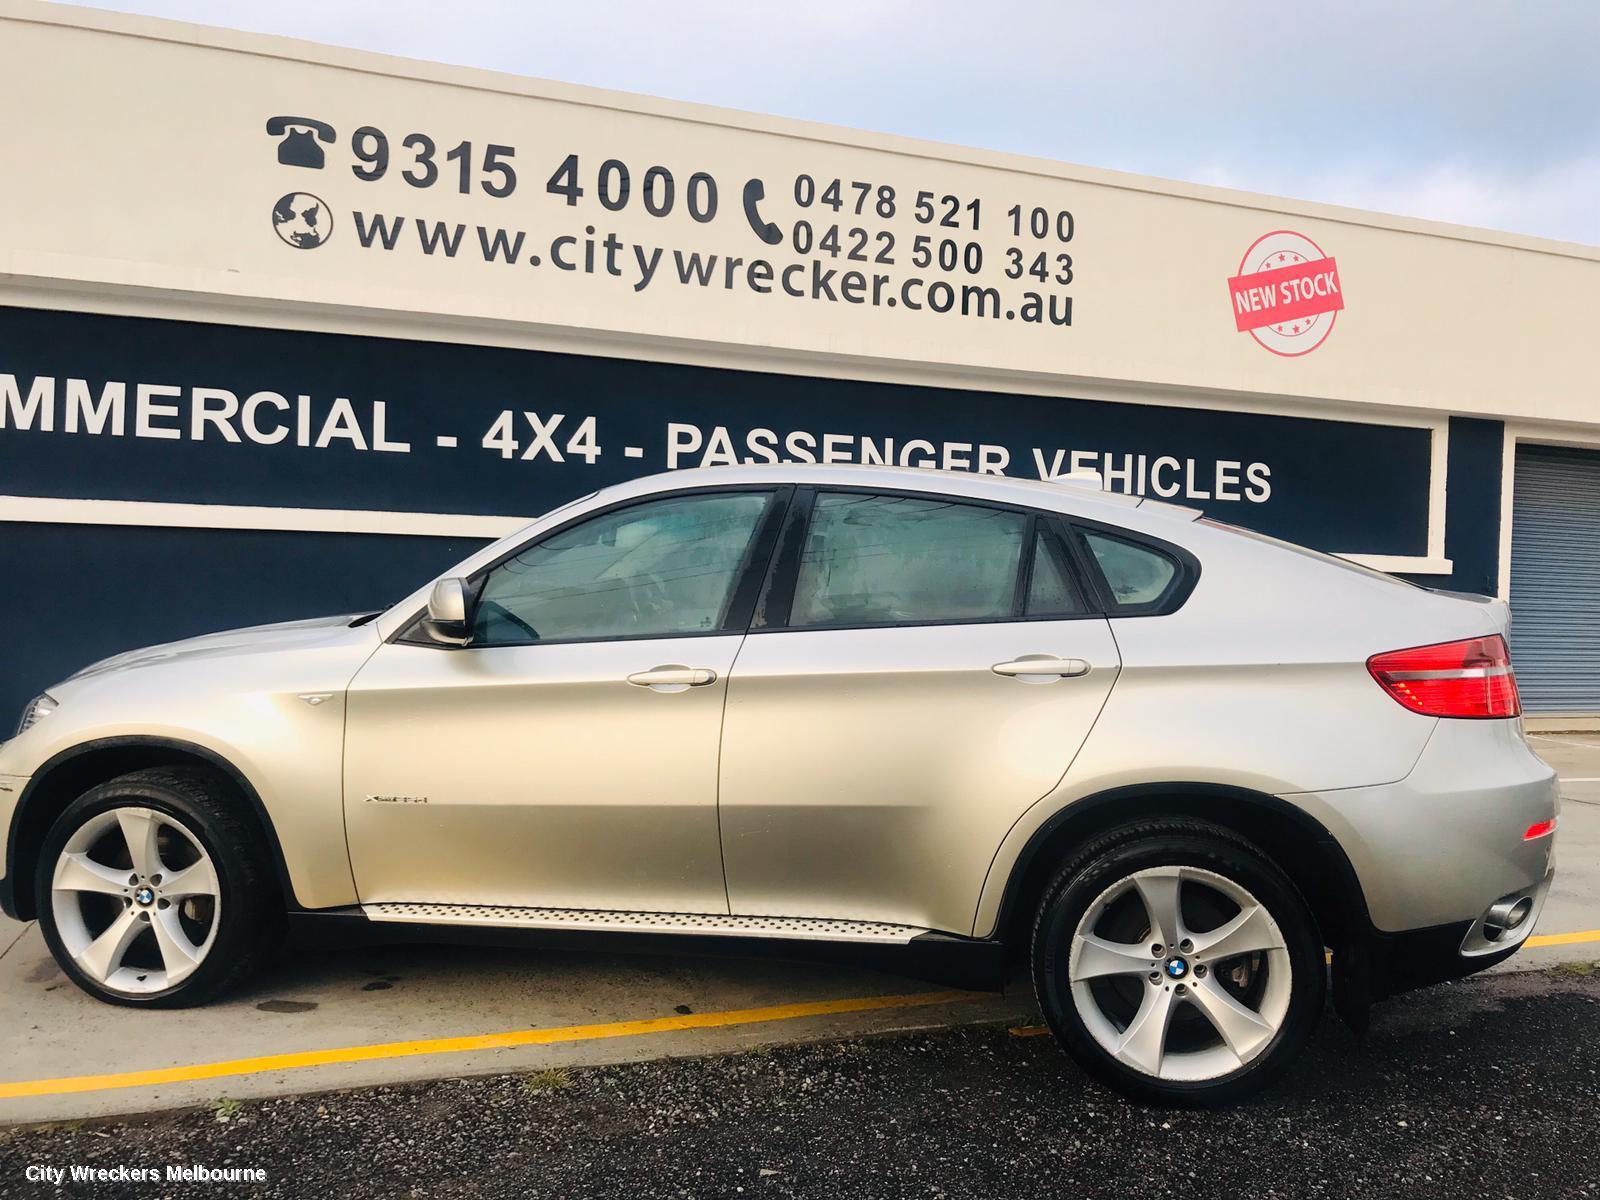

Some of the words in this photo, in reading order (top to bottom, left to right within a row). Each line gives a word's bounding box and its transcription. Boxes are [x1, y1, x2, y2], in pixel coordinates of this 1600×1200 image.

[352, 126, 517, 199] 9315
[546, 154, 719, 224] 4000
[793, 174, 896, 219] 0478
[914, 191, 981, 231] 521
[1007, 205, 1075, 243] 100
[352, 211, 1073, 327] www.citywrecker.com.au
[792, 220, 896, 265] 0422
[911, 235, 983, 275] 500
[1004, 248, 1074, 286] 343
[0, 374, 411, 453] MMERCIAL
[482, 410, 602, 465] 4X4
[666, 423, 1010, 477] PASSENGER
